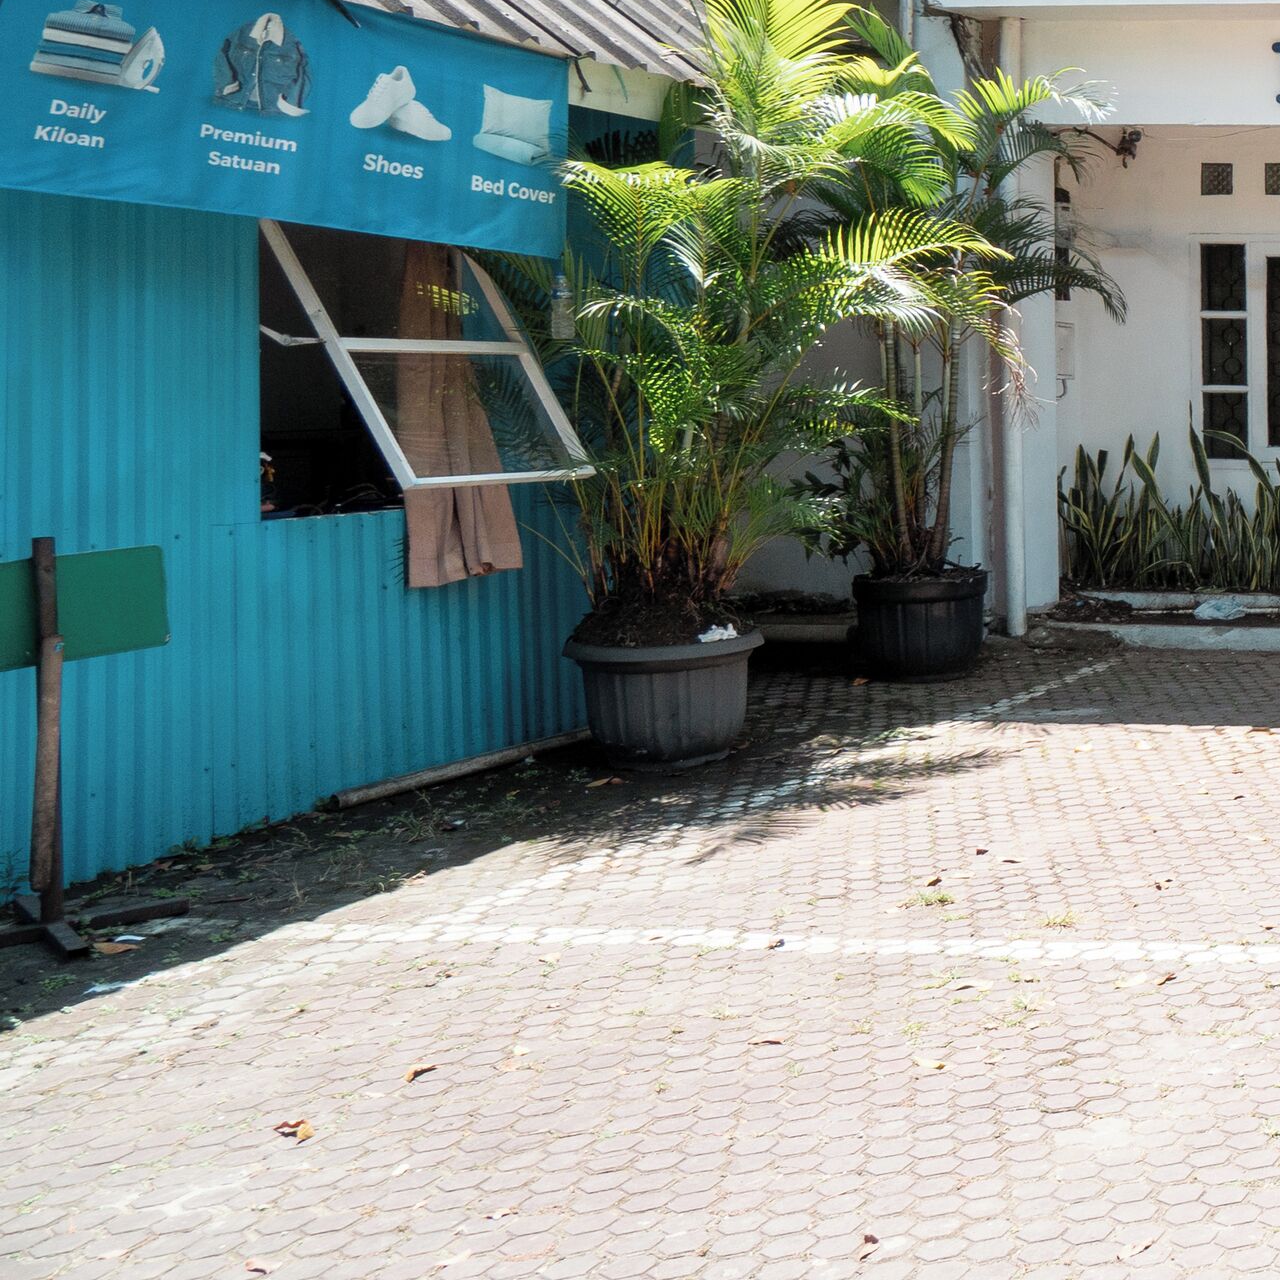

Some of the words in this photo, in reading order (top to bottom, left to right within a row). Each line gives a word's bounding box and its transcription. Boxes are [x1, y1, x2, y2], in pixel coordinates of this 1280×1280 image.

[50, 99, 106, 123] Daily
[34, 125, 105, 149] Kiloan
[200, 124, 297, 152] Premium
[208, 151, 280, 175] Satuan
[363, 153, 424, 180] Shoes
[471, 174, 504, 196] Bed
[507, 182, 556, 204] Cover
